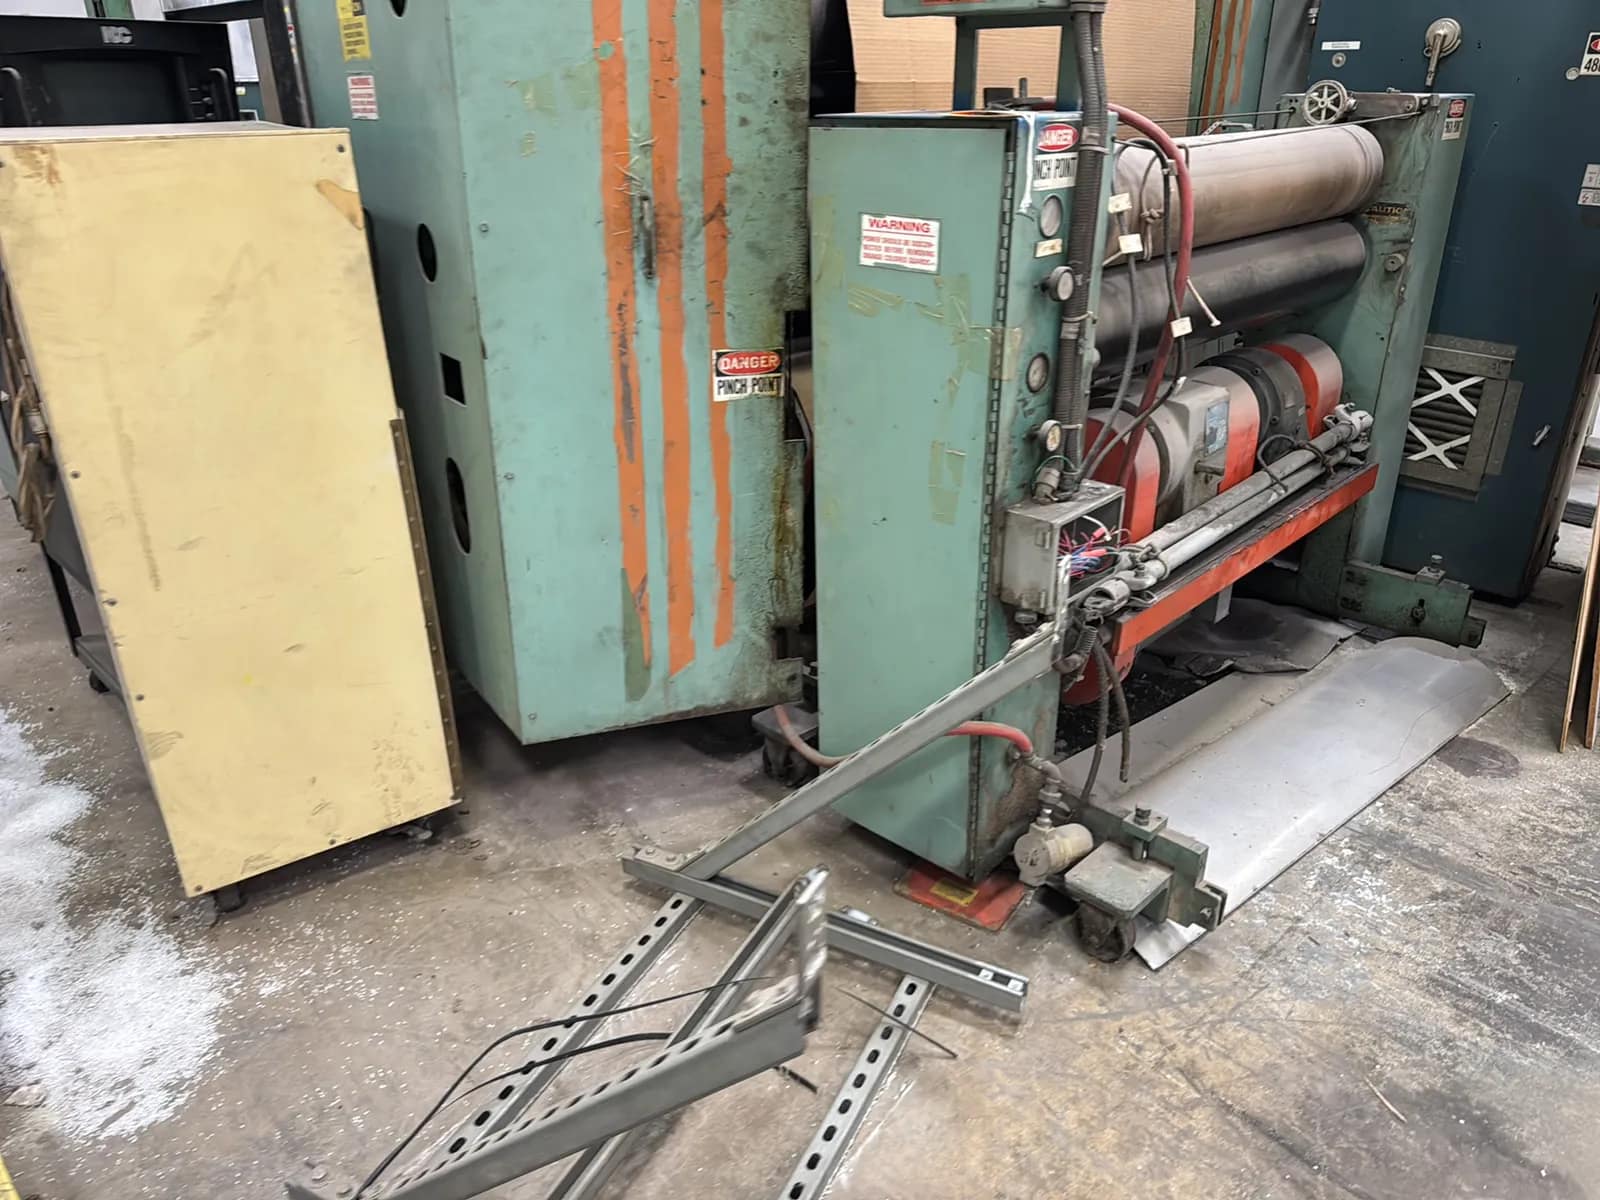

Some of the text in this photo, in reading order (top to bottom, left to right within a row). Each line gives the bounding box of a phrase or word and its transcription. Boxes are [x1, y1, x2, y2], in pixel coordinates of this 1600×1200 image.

[1584, 58, 1600, 72] 48
[869, 218, 931, 233] WARNING
[720, 355, 779, 370] DANGER
[717, 376, 783, 395] PINCH POINT
